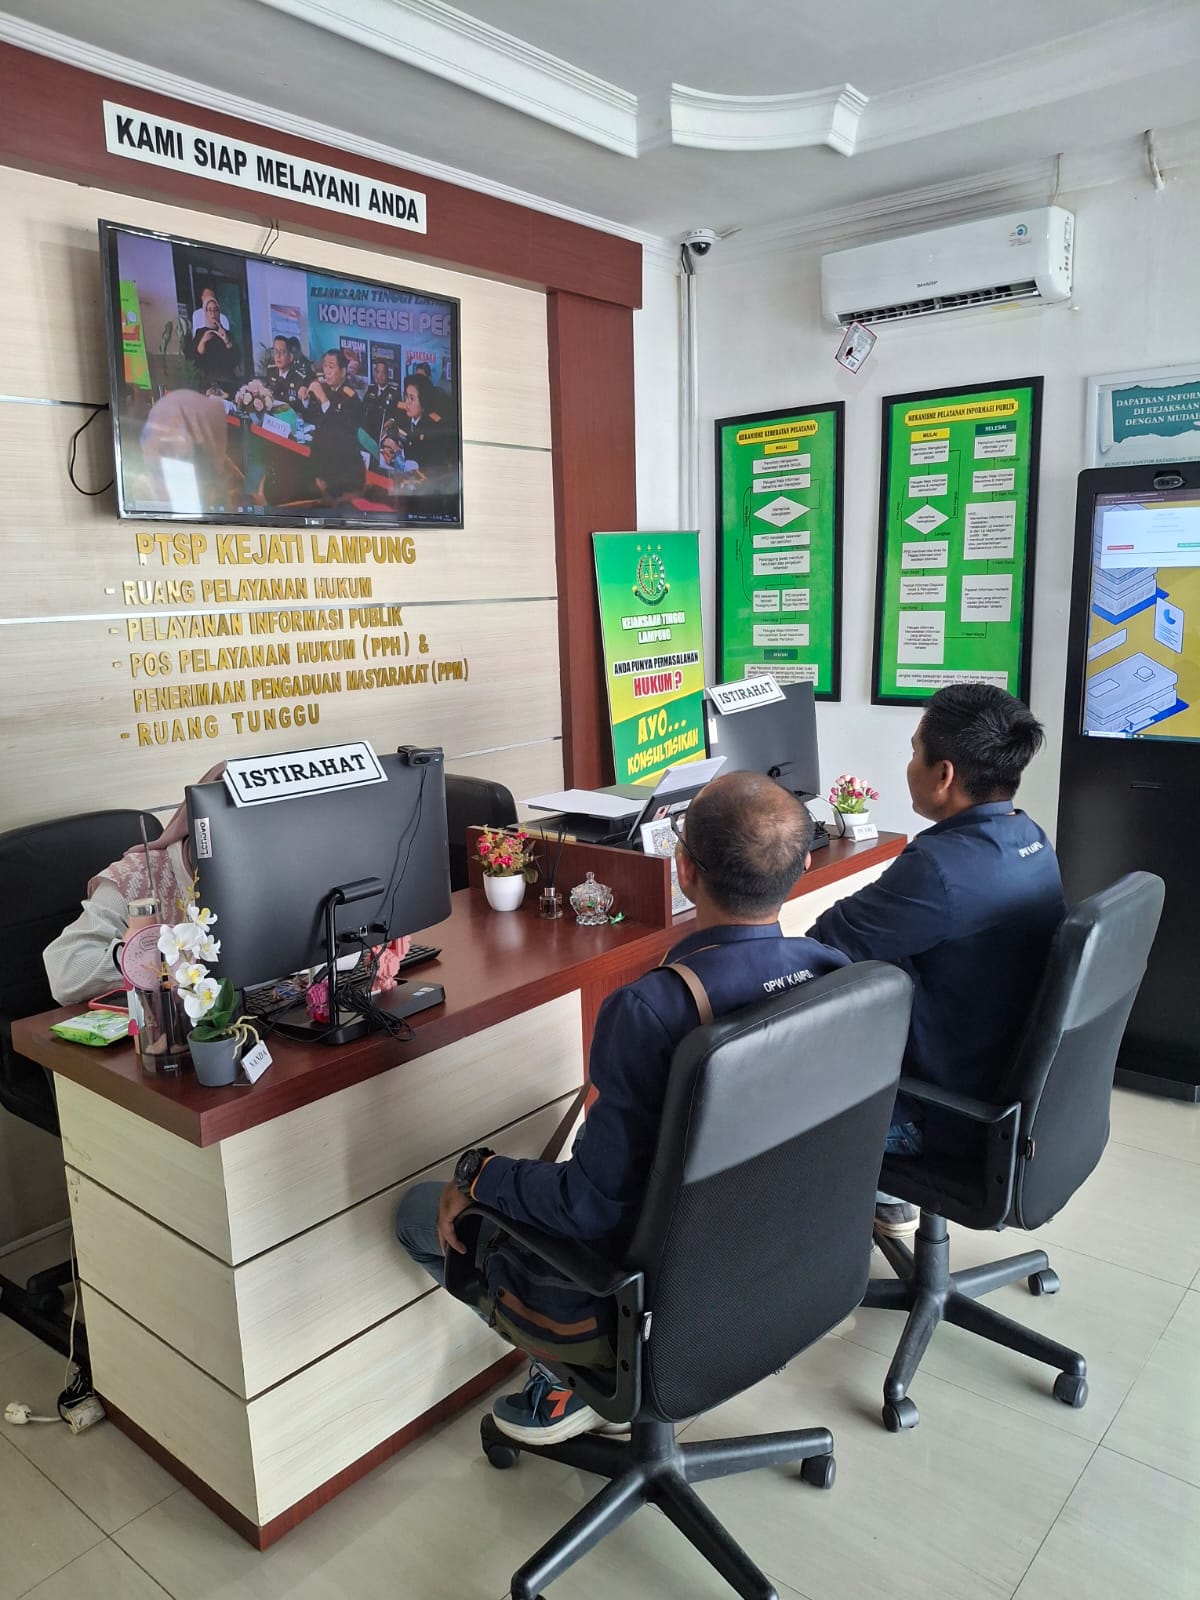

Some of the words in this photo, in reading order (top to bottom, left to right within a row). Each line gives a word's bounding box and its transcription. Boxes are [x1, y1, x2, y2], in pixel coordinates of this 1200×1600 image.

[116, 115, 184, 160] KAMI
[193, 138, 248, 176] SIAP
[256, 155, 360, 208] MELAYANI
[368, 188, 419, 223] ANDA
[319, 303, 414, 332] KONFERENSI
[1116, 395, 1164, 407] DAPATKAN
[1133, 408, 1144, 416] DI
[1146, 402, 1200, 414] KEJAKSAAN
[1125, 416, 1165, 426] DENGAN
[136, 533, 207, 566] PTSP
[216, 534, 305, 564] KEJATI
[312, 535, 416, 564] LAMPUNG
[122, 580, 194, 605] RUANG
[201, 577, 308, 603] PELAYANAN
[315, 576, 373, 598] HUKUM
[127, 614, 244, 641] PELAYANAN
[249, 608, 344, 633] INFORMASI
[349, 606, 403, 628] PUBLIK
[661, 611, 686, 625] TINGGI
[130, 652, 172, 678] POS
[179, 643, 289, 674] PELAYANAN
[297, 638, 356, 664] HUKUM
[363, 632, 410, 659] (PPH)
[418, 633, 429, 654] &
[614, 661, 631, 675] ANDA
[631, 658, 653, 673] PUNYA
[653, 652, 698, 669] PERMASALAHAN
[133, 680, 246, 713] PENERIMAAN
[252, 672, 342, 700] PENGADUAN
[346, 663, 430, 691] MASYARAKAT
[431, 658, 469, 685] (PPM)
[634, 672, 673, 697] HUKUM
[675, 671, 682, 689] ?
[718, 681, 774, 705] ISTIRAHAT
[137, 714, 219, 747] RUANG
[232, 703, 321, 734] TUNGGU
[638, 709, 687, 745] AYO...
[627, 728, 699, 776] KONSULTASIKAN
[238, 754, 368, 789] ISTIRAHAT
